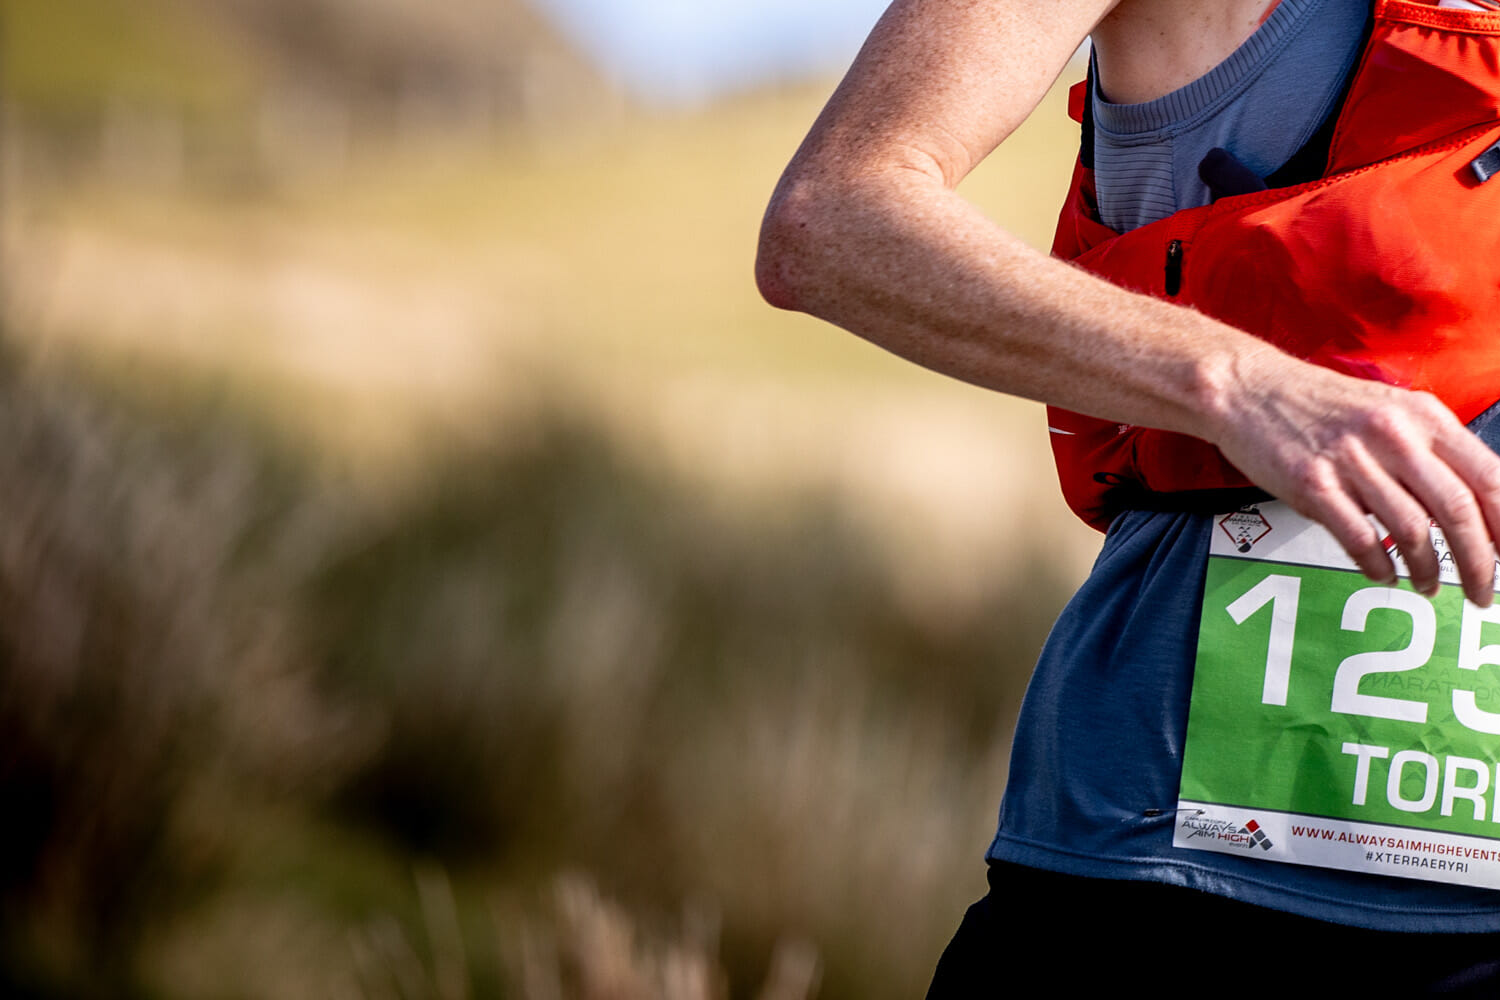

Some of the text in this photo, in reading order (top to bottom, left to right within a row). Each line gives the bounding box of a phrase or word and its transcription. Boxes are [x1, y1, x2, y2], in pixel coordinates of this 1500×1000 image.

[1181, 820, 1237, 834] ALWAYS
[1186, 829, 1250, 843] AIM HIGH
[1366, 851, 1469, 874] #XTERRAERYRI
